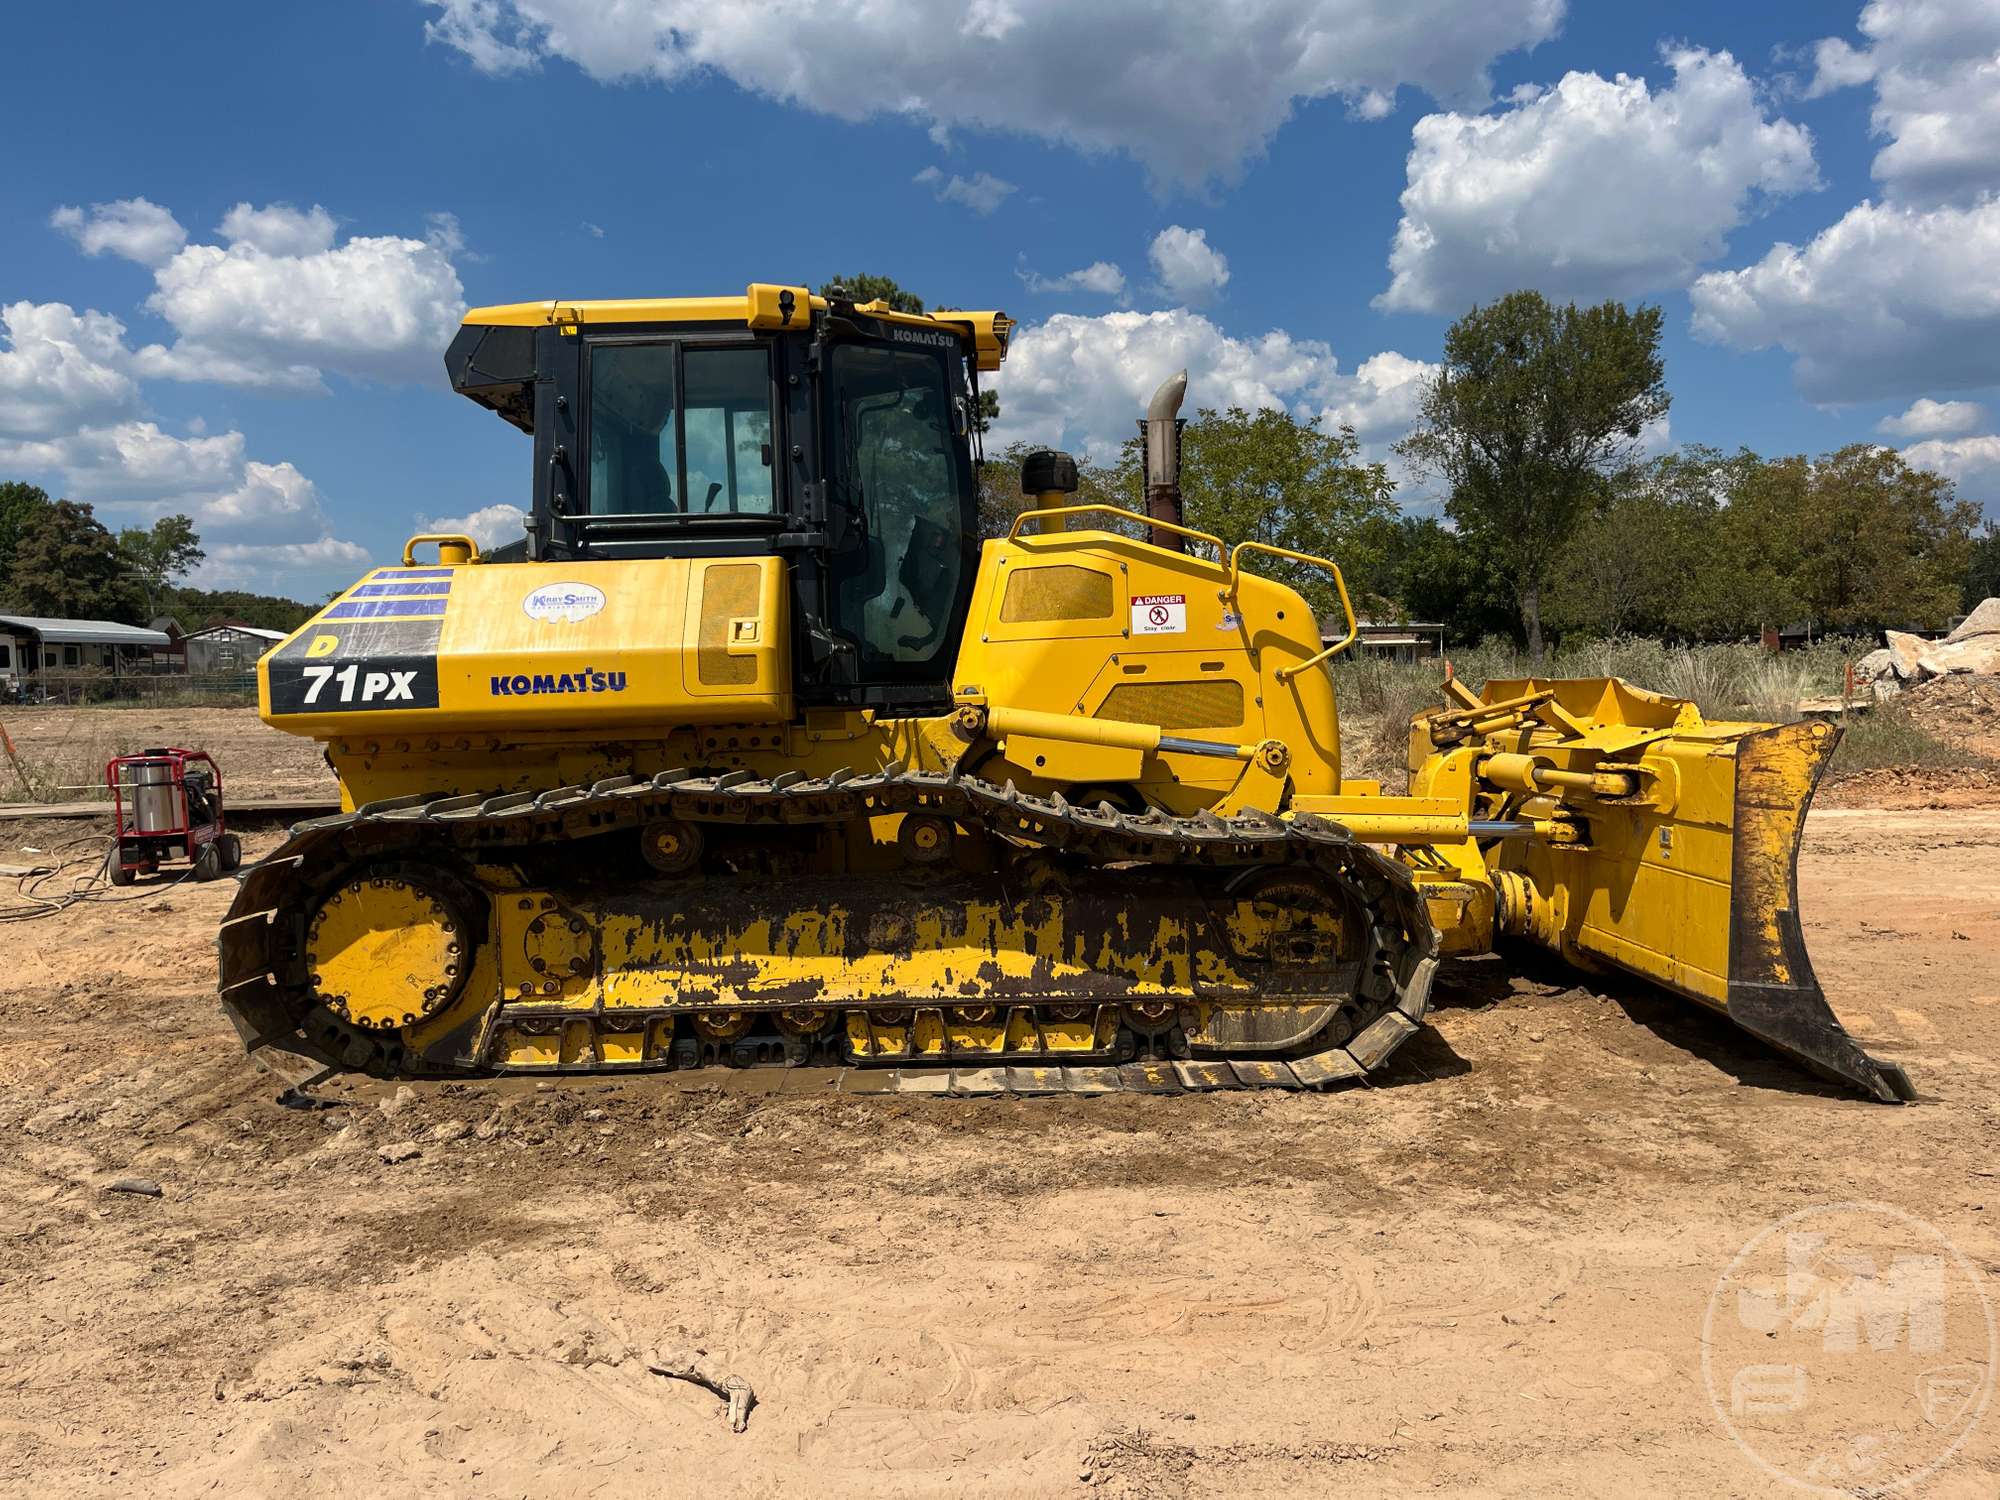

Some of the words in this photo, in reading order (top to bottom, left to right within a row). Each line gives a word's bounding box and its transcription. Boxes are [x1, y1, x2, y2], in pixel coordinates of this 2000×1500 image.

[893, 329, 954, 348] KOMATSU
[1144, 595, 1182, 605] DANGER
[305, 635, 339, 658] D
[490, 667, 627, 696] KOMATSU
